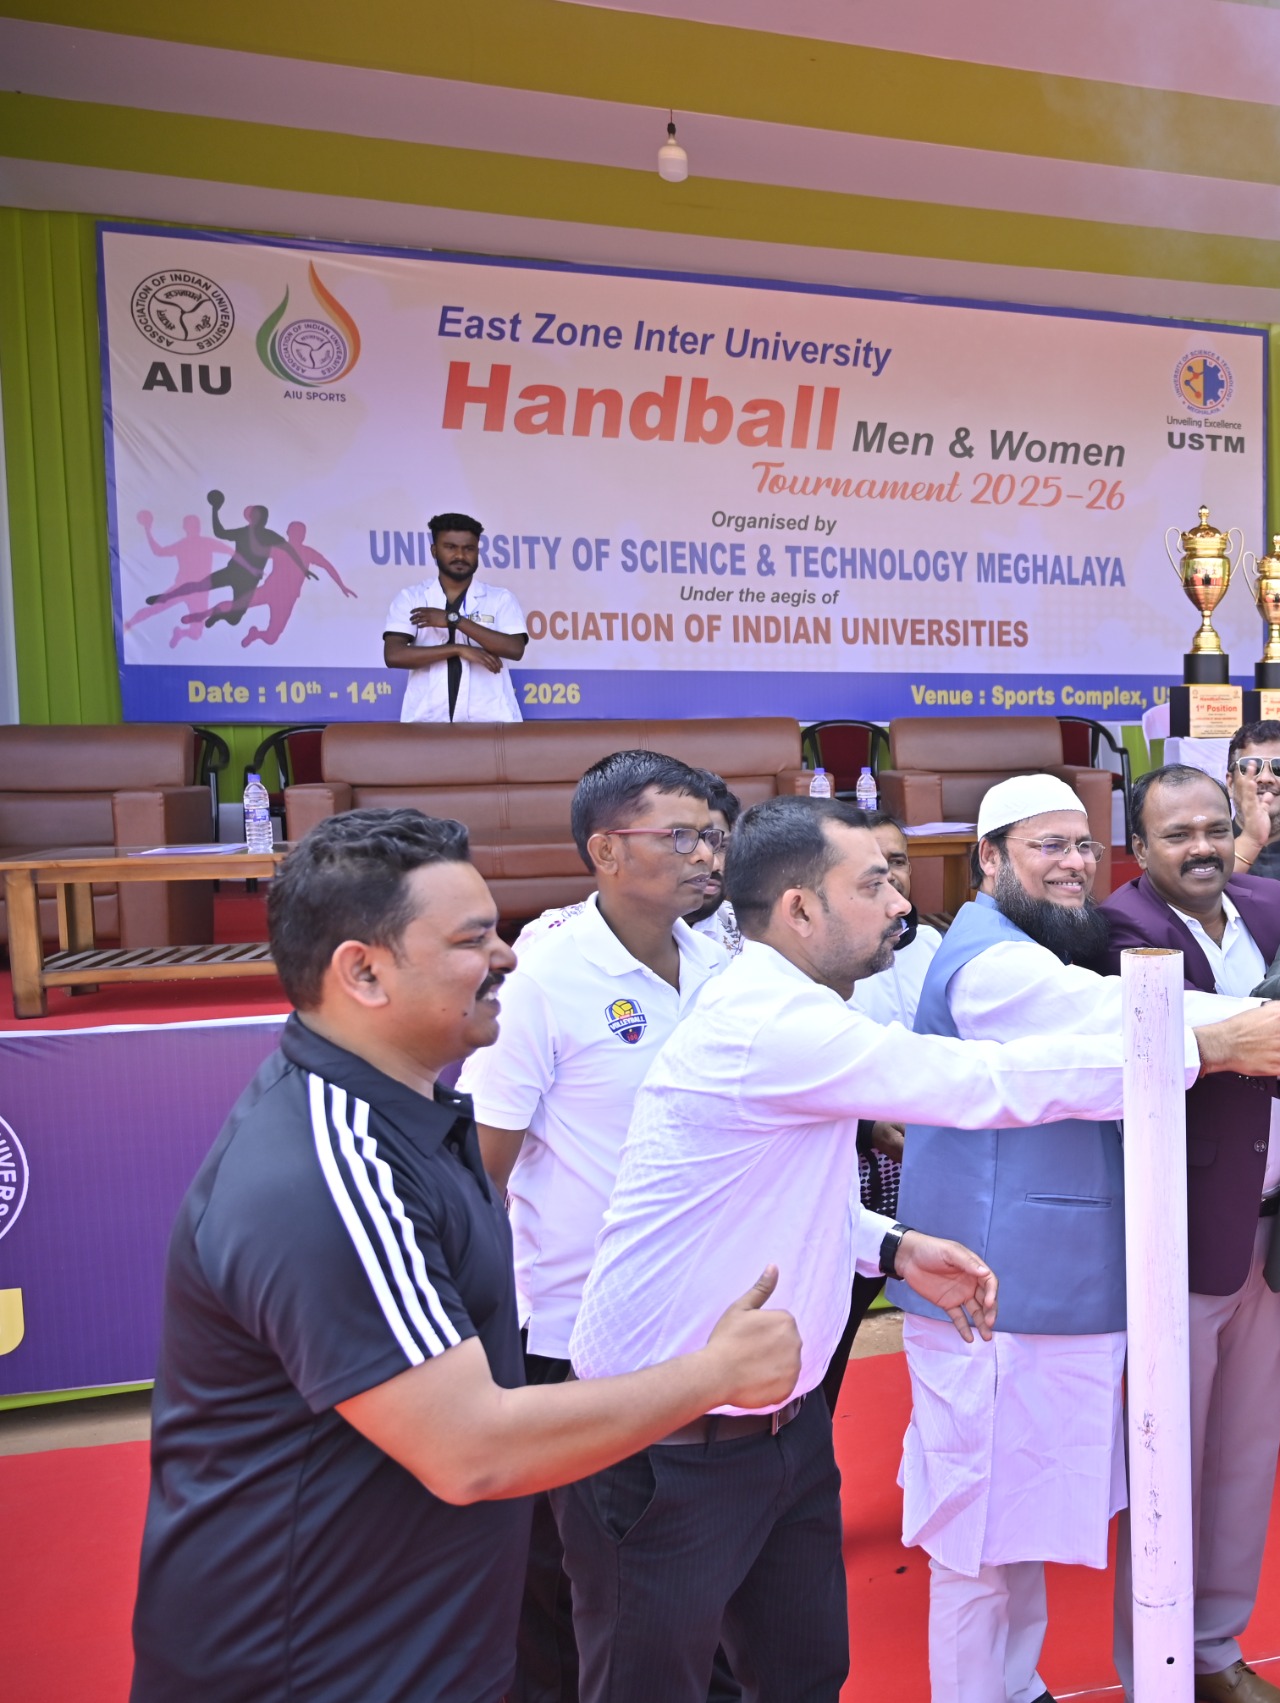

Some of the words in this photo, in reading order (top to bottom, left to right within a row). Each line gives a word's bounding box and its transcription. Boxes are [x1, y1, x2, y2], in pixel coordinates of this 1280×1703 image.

[152, 275, 167, 287] OF
[170, 273, 211, 291] INDIAN
[136, 285, 174, 347] ASSOCIATION
[196, 290, 230, 350] UNIVERSITIES
[293, 324, 303, 333] OF
[304, 323, 330, 335] INDIAN
[437, 305, 522, 342] East
[532, 312, 623, 350] Zone
[633, 319, 714, 356] Inter
[725, 327, 892, 376] University
[283, 332, 306, 373] ASSOCIATION
[321, 335, 343, 375] UNIVERSITIES
[142, 361, 232, 396] AIU
[284, 390, 303, 400] AIU
[306, 391, 346, 402] SPORTS
[441, 360, 841, 451] Handball
[1166, 415, 1202, 428] Unveiling
[1204, 418, 1242, 430] Excellence
[852, 420, 934, 456] Men
[948, 427, 975, 459] &
[989, 429, 1126, 467] Women
[1167, 431, 1245, 454] USTM
[752, 461, 962, 503] Tournament
[711, 511, 809, 535] Organised
[815, 515, 837, 536] by
[369, 530, 562, 570] UNIRSITY
[572, 537, 610, 571] OF
[621, 539, 746, 577] SCIENCE
[757, 543, 775, 577] &
[785, 545, 968, 582] TECHNOLOGY
[977, 552, 1126, 587] MEGHALAYA
[679, 586, 733, 602] Under
[738, 587, 766, 603] the
[770, 589, 816, 608] aegis
[821, 590, 840, 605] of
[525, 611, 674, 643] OCIATION
[684, 614, 721, 642] OF
[732, 614, 831, 644] INDIAN
[841, 617, 1029, 648] UNIVERSITIES
[188, 680, 250, 703] Date
[259, 686, 266, 703] :
[275, 681, 321, 703] 10th
[346, 681, 391, 703] 14th
[524, 683, 580, 704] 2026
[911, 685, 973, 705] Venue
[980, 690, 986, 705] :
[992, 686, 1055, 709] Sports
[1061, 686, 1147, 709] Complex,
[1207, 704, 1238, 712] Position
